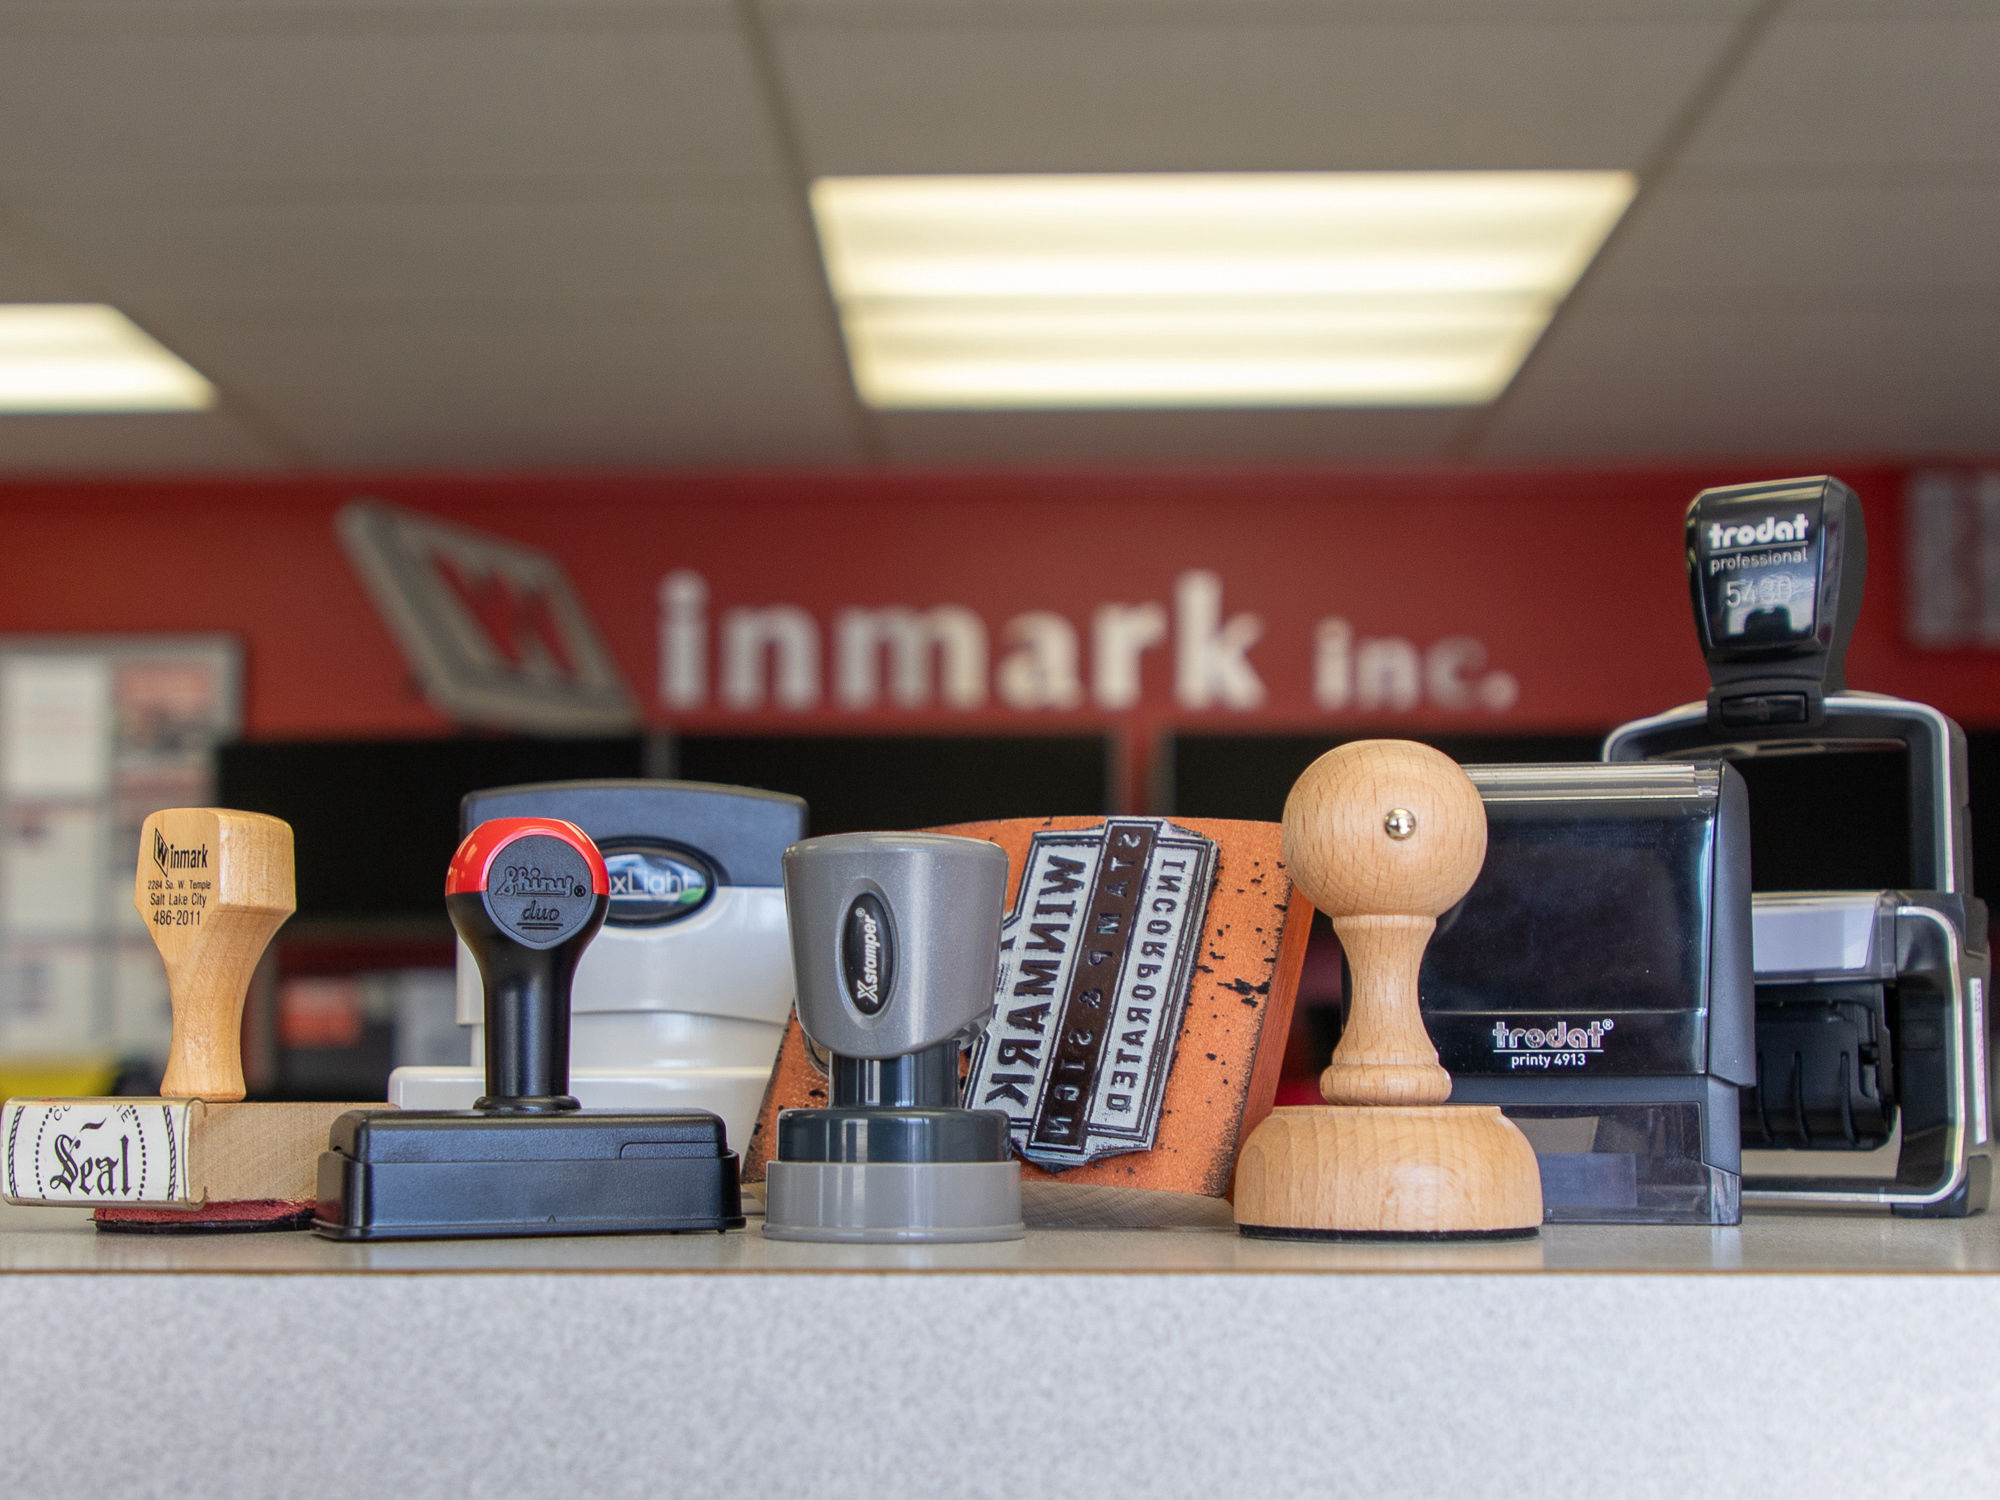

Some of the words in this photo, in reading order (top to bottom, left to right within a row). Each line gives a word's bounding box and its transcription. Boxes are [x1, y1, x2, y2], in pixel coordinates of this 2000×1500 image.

[1708, 513, 1809, 549] trodat
[1710, 547, 1808, 576] professional
[189, 880, 211, 892] Temple
[608, 867, 690, 895] xLight
[150, 893, 165, 906] Salt
[168, 893, 188, 906] Lake
[191, 893, 207, 908] City
[520, 900, 561, 922] duo
[153, 910, 201, 926] 486-2011
[1511, 1053, 1551, 1069] printy
[1554, 1053, 1586, 1066] 4913
[50, 1134, 132, 1197] Seal
